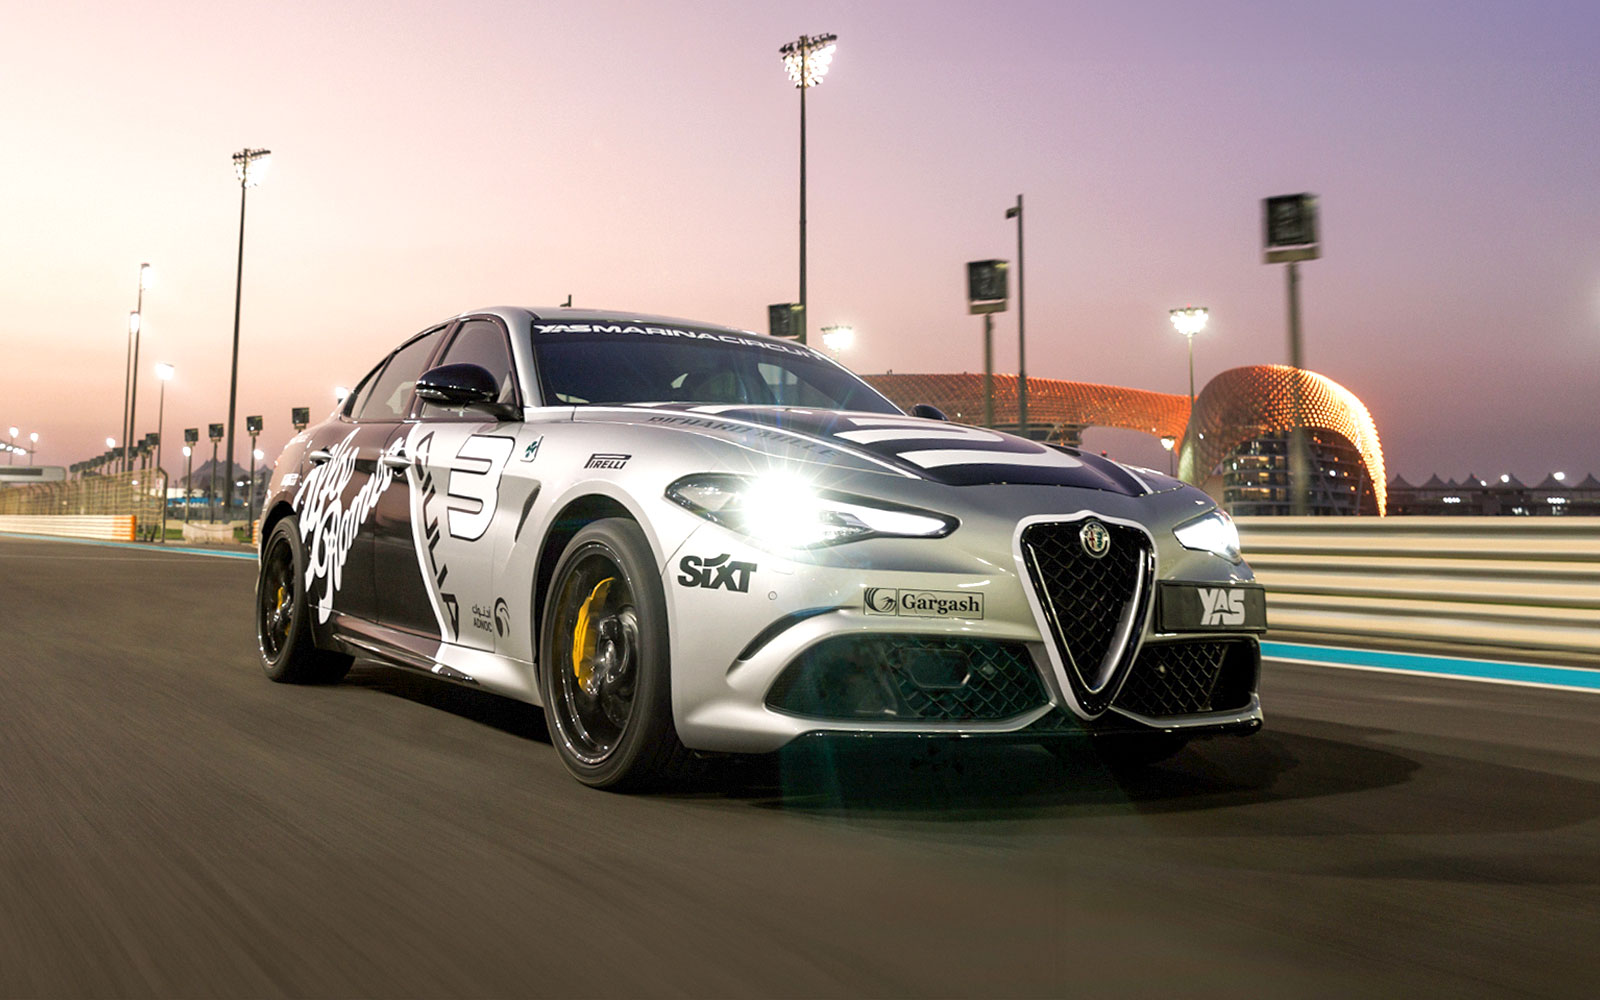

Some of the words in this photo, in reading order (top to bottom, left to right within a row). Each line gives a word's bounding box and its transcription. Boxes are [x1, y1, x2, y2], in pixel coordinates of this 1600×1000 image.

[584, 453, 632, 469] PIRELLI
[902, 594, 980, 614] Gargash
[1198, 589, 1245, 625] YAS
[473, 617, 493, 632] ADNOC
